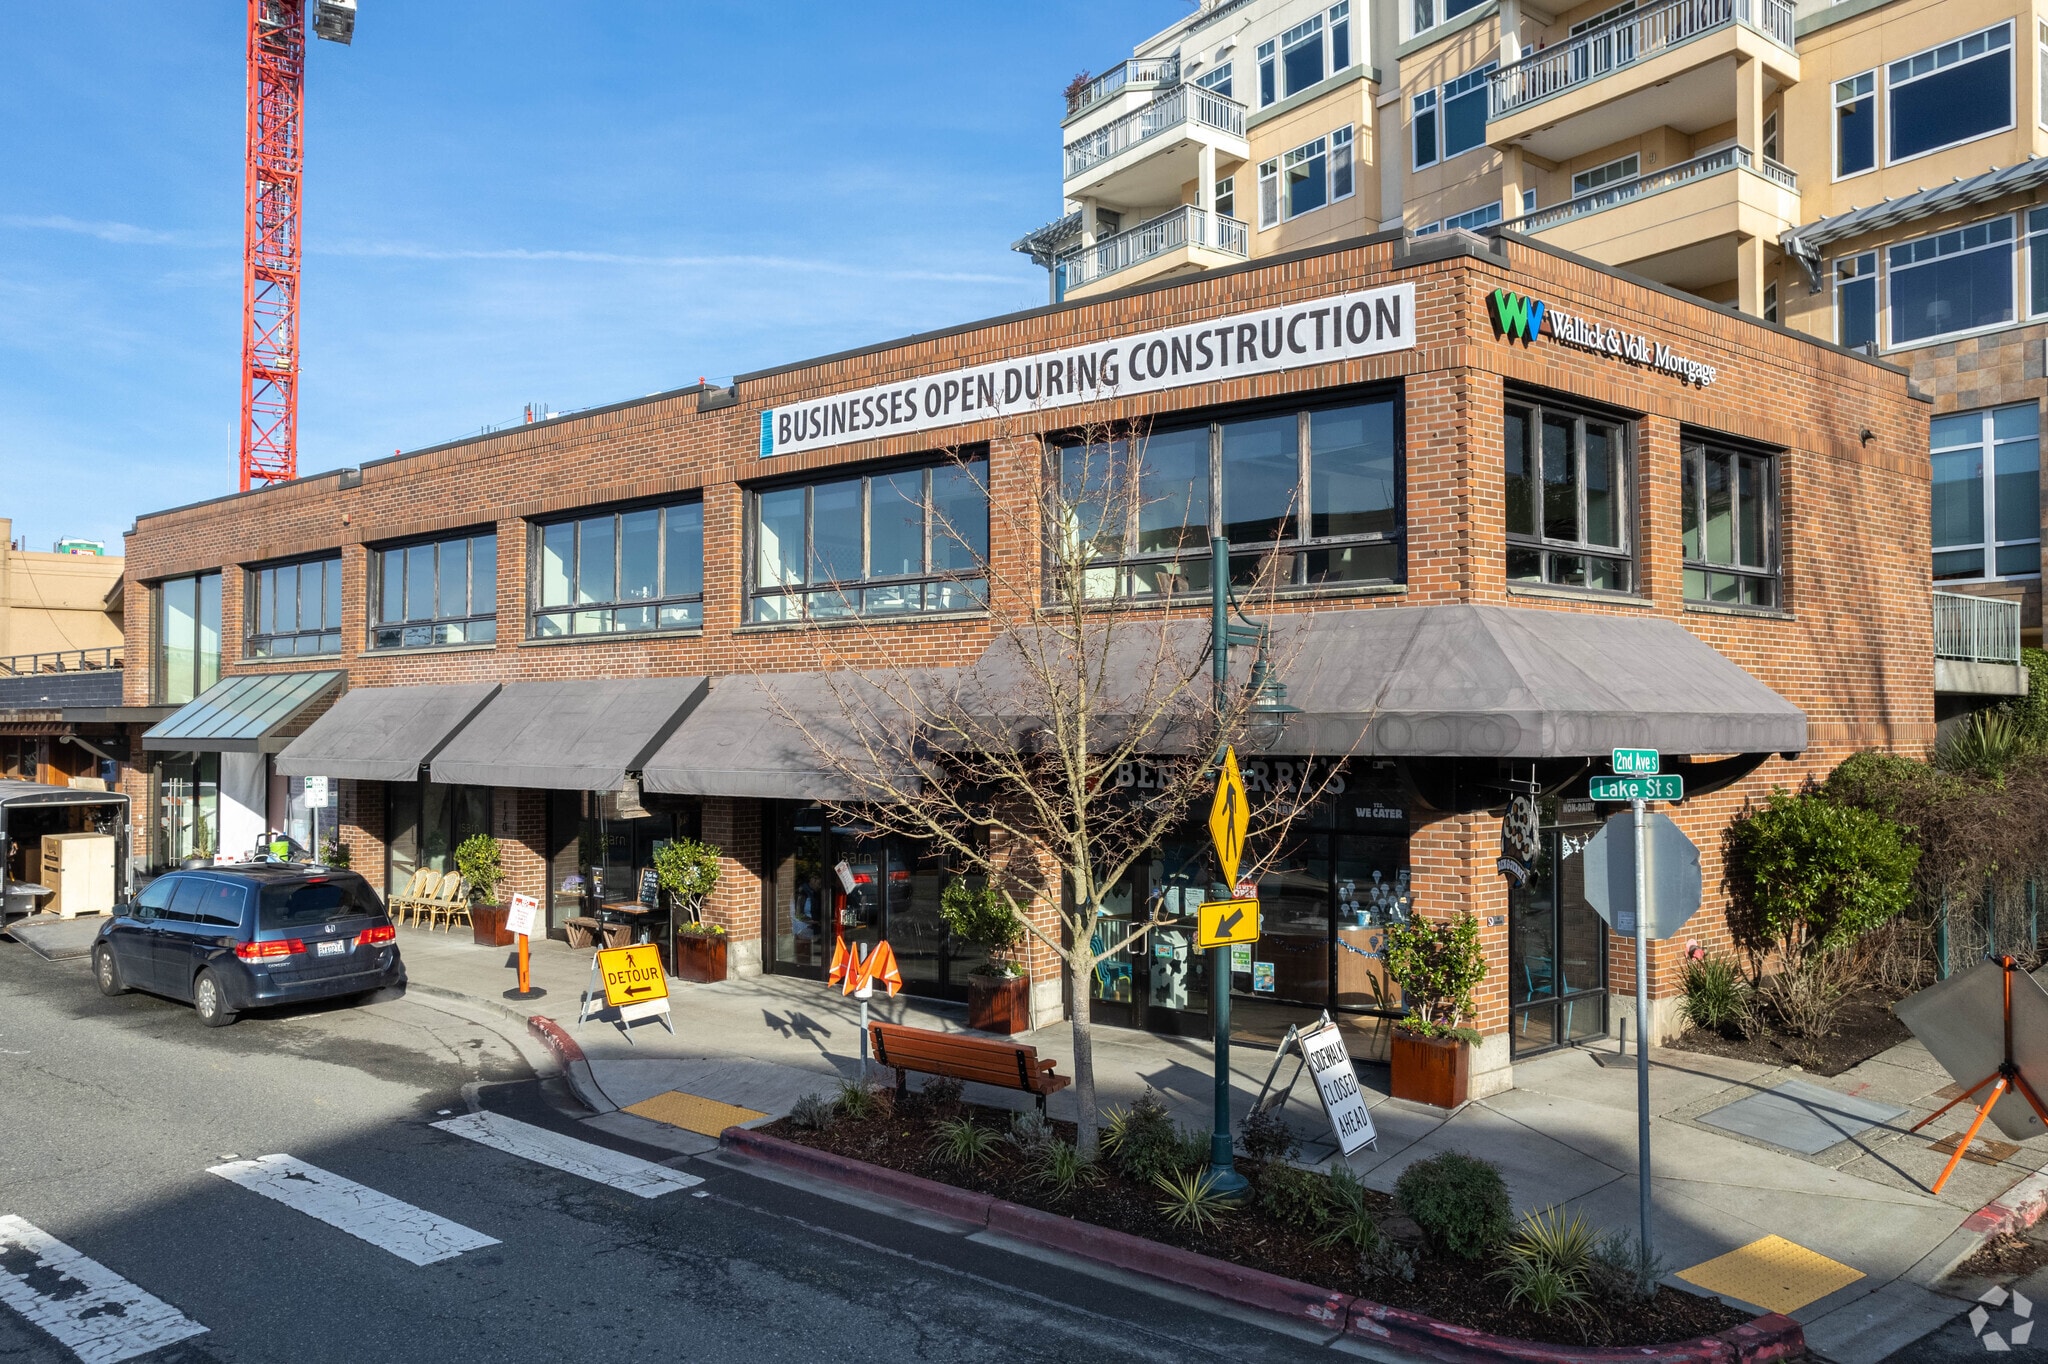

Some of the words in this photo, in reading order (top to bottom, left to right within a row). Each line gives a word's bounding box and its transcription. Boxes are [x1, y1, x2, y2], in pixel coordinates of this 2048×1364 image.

[1550, 310, 1605, 351] Wallick
[1606, 327, 1621, 354] &
[1620, 330, 1651, 364] Volk
[1655, 342, 1716, 386] Mortgage
[778, 387, 917, 445] BUSINESSES
[925, 372, 994, 418] OPEN
[1004, 348, 1119, 405] DURING
[1128, 294, 1401, 382] CONSTRUCTION
[1118, 759, 1177, 788] BEN
[1234, 757, 1346, 794] RRY'S
[1616, 752, 1632, 770] 2nd
[1635, 752, 1650, 770] Ave
[1600, 779, 1639, 797] Lake
[1645, 778, 1662, 797] St
[1355, 807, 1372, 818] WE
[1372, 807, 1403, 819] CATER
[1562, 803, 1596, 813] NON-DAIRY
[608, 967, 659, 985] DETOUR
[1310, 1040, 1347, 1073] SIDEWALK
[1323, 1073, 1357, 1106] CLOSED
[1338, 1106, 1368, 1138] AHEAD
